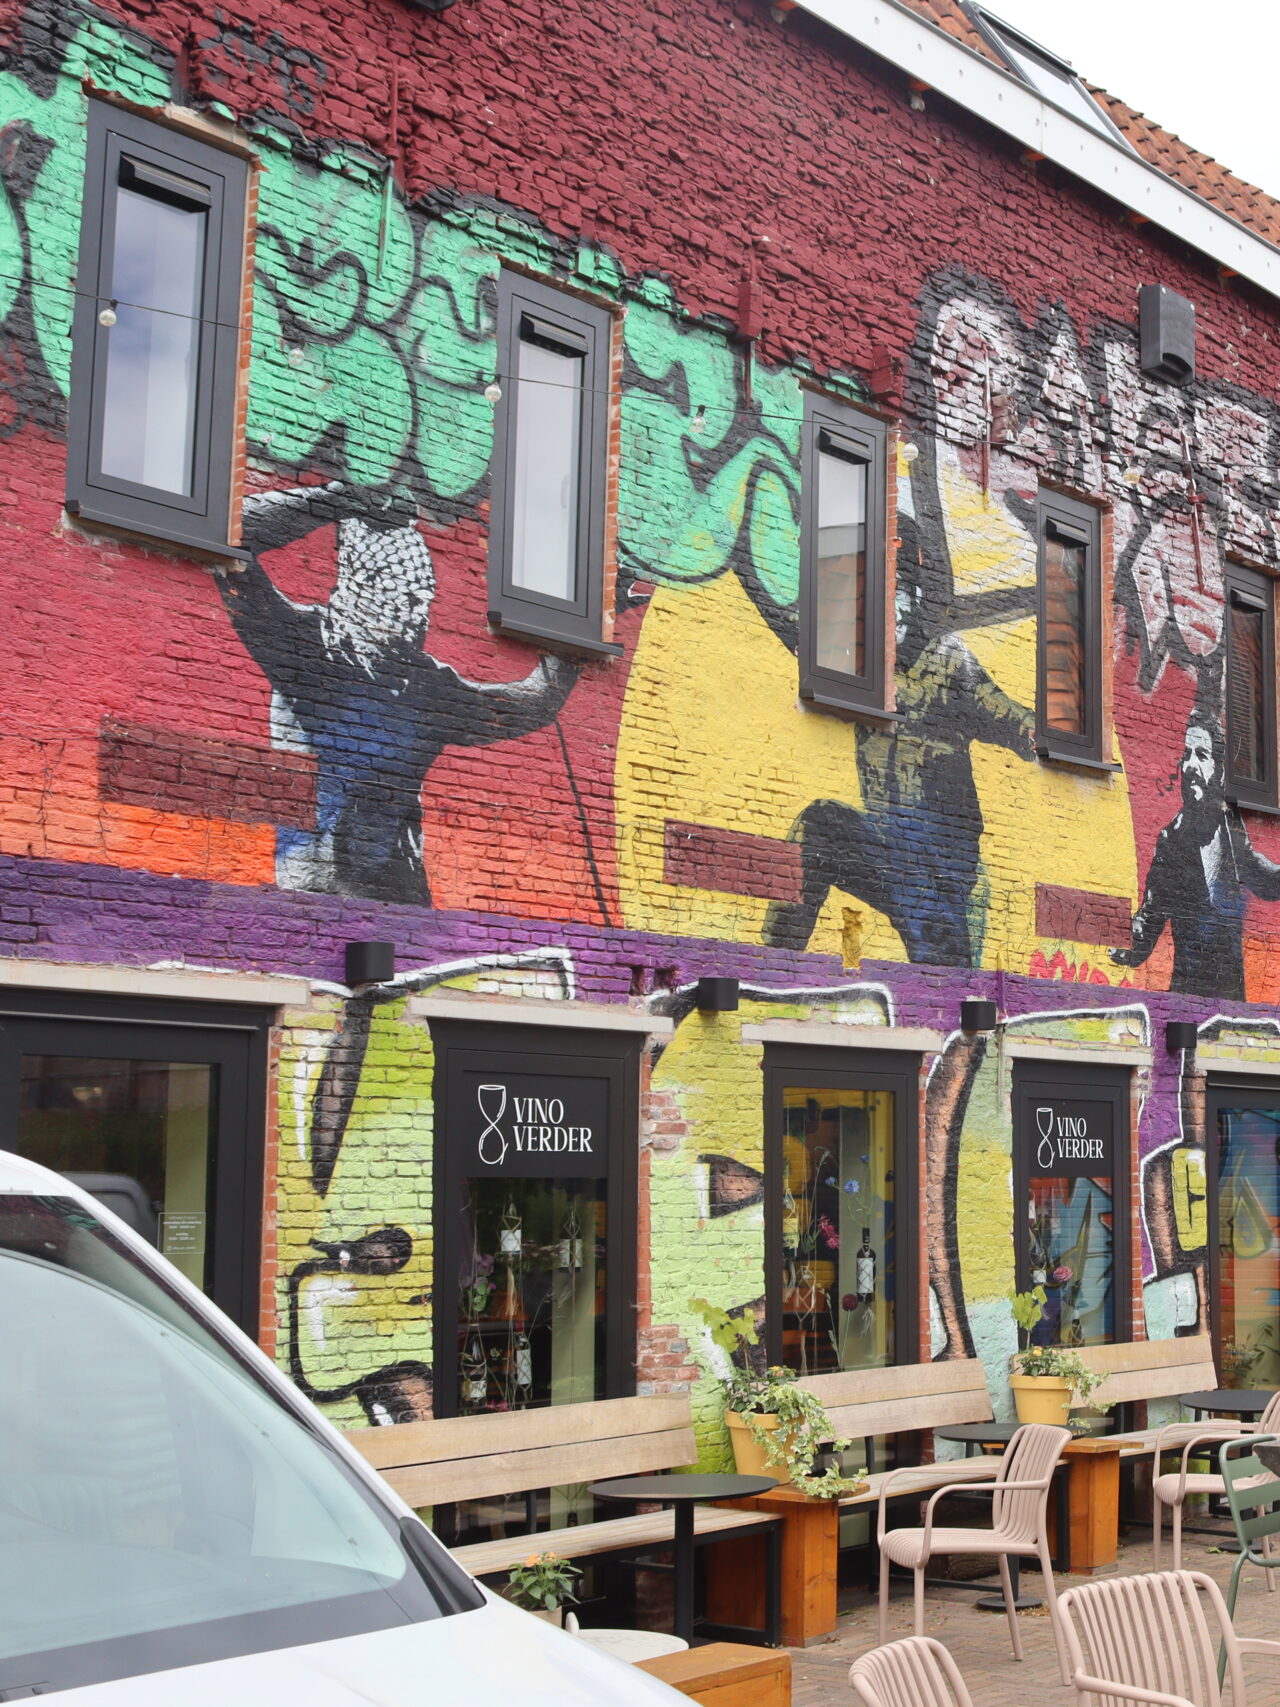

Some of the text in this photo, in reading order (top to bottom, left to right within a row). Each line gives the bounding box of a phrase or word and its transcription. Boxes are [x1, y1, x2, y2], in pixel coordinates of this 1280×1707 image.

[512, 1097, 565, 1125] VINO
[512, 1125, 594, 1153] VERDER
[1056, 1116, 1087, 1138] VINO
[1056, 1138, 1104, 1159] VERDER
